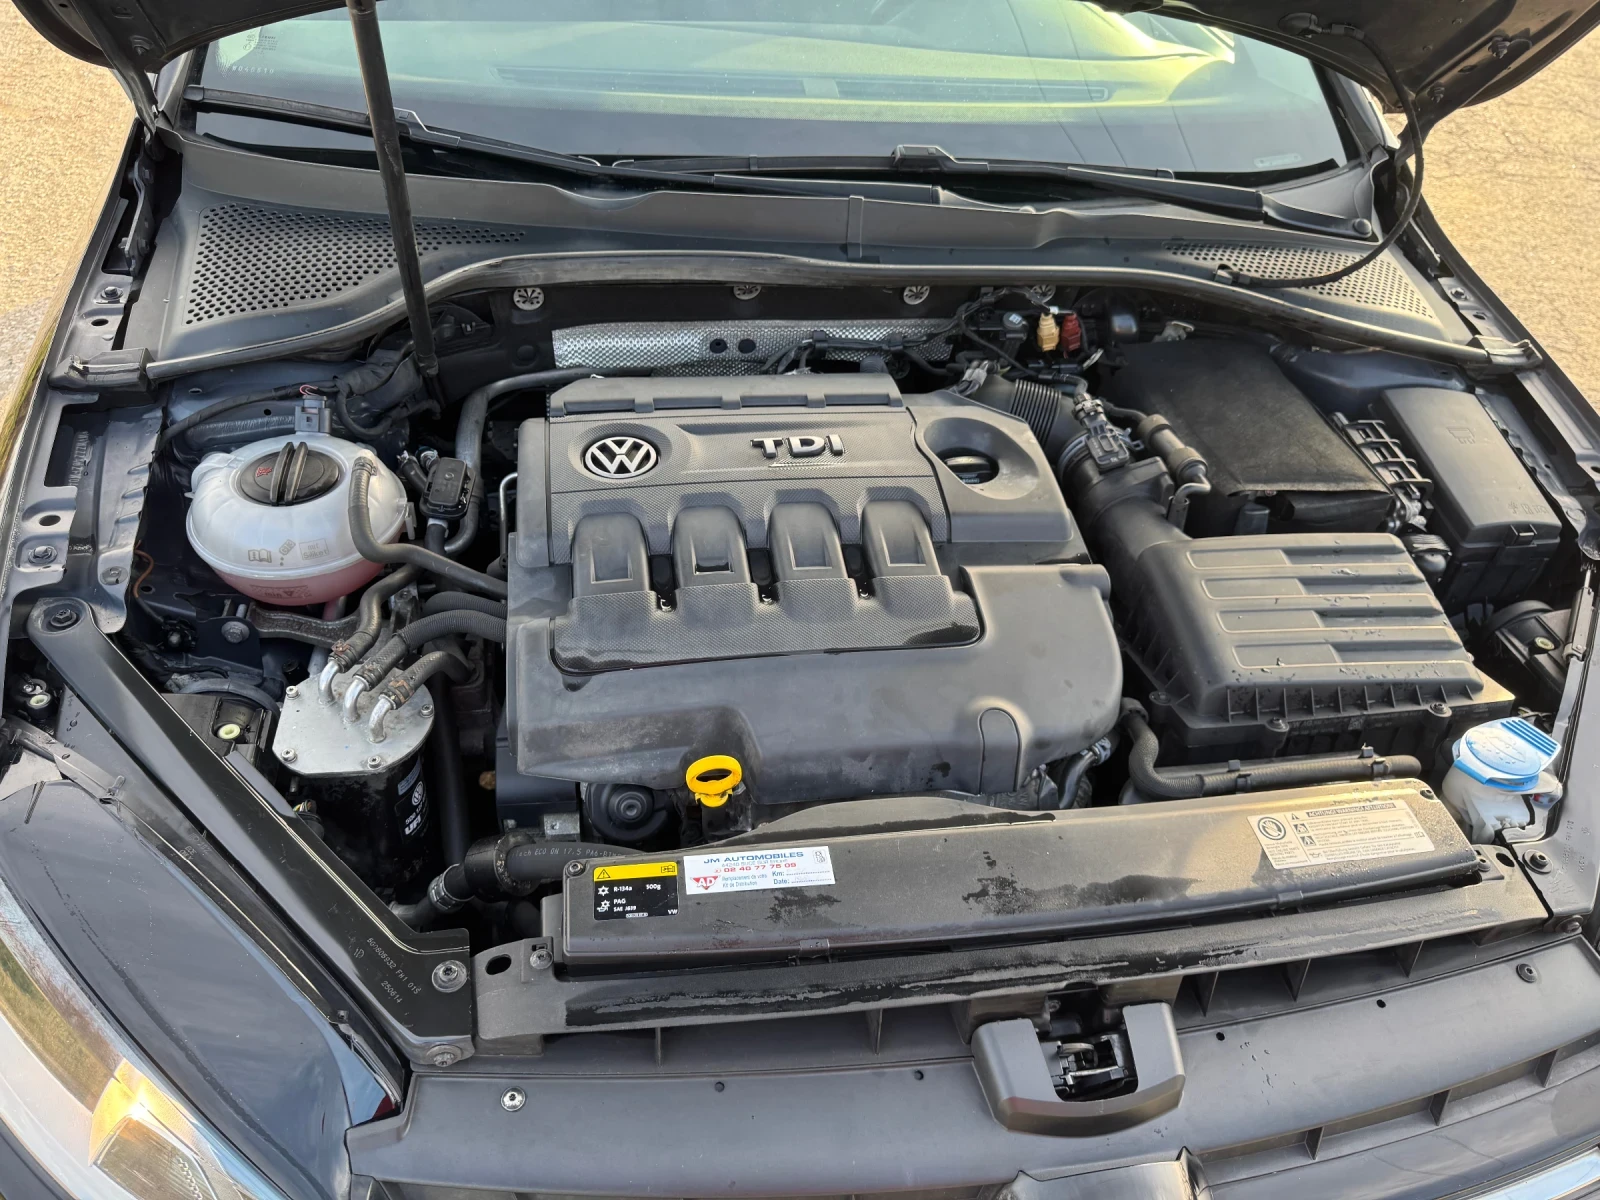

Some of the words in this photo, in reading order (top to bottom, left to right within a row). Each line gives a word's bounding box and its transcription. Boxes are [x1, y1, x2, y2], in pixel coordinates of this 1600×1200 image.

[751, 434, 844, 458] TDI
[585, 436, 657, 478] VW
[405, 814, 421, 835] UFI
[724, 852, 804, 862] AUTOMOBILES
[613, 885, 633, 893] R-134a
[696, 877, 715, 888] AD
